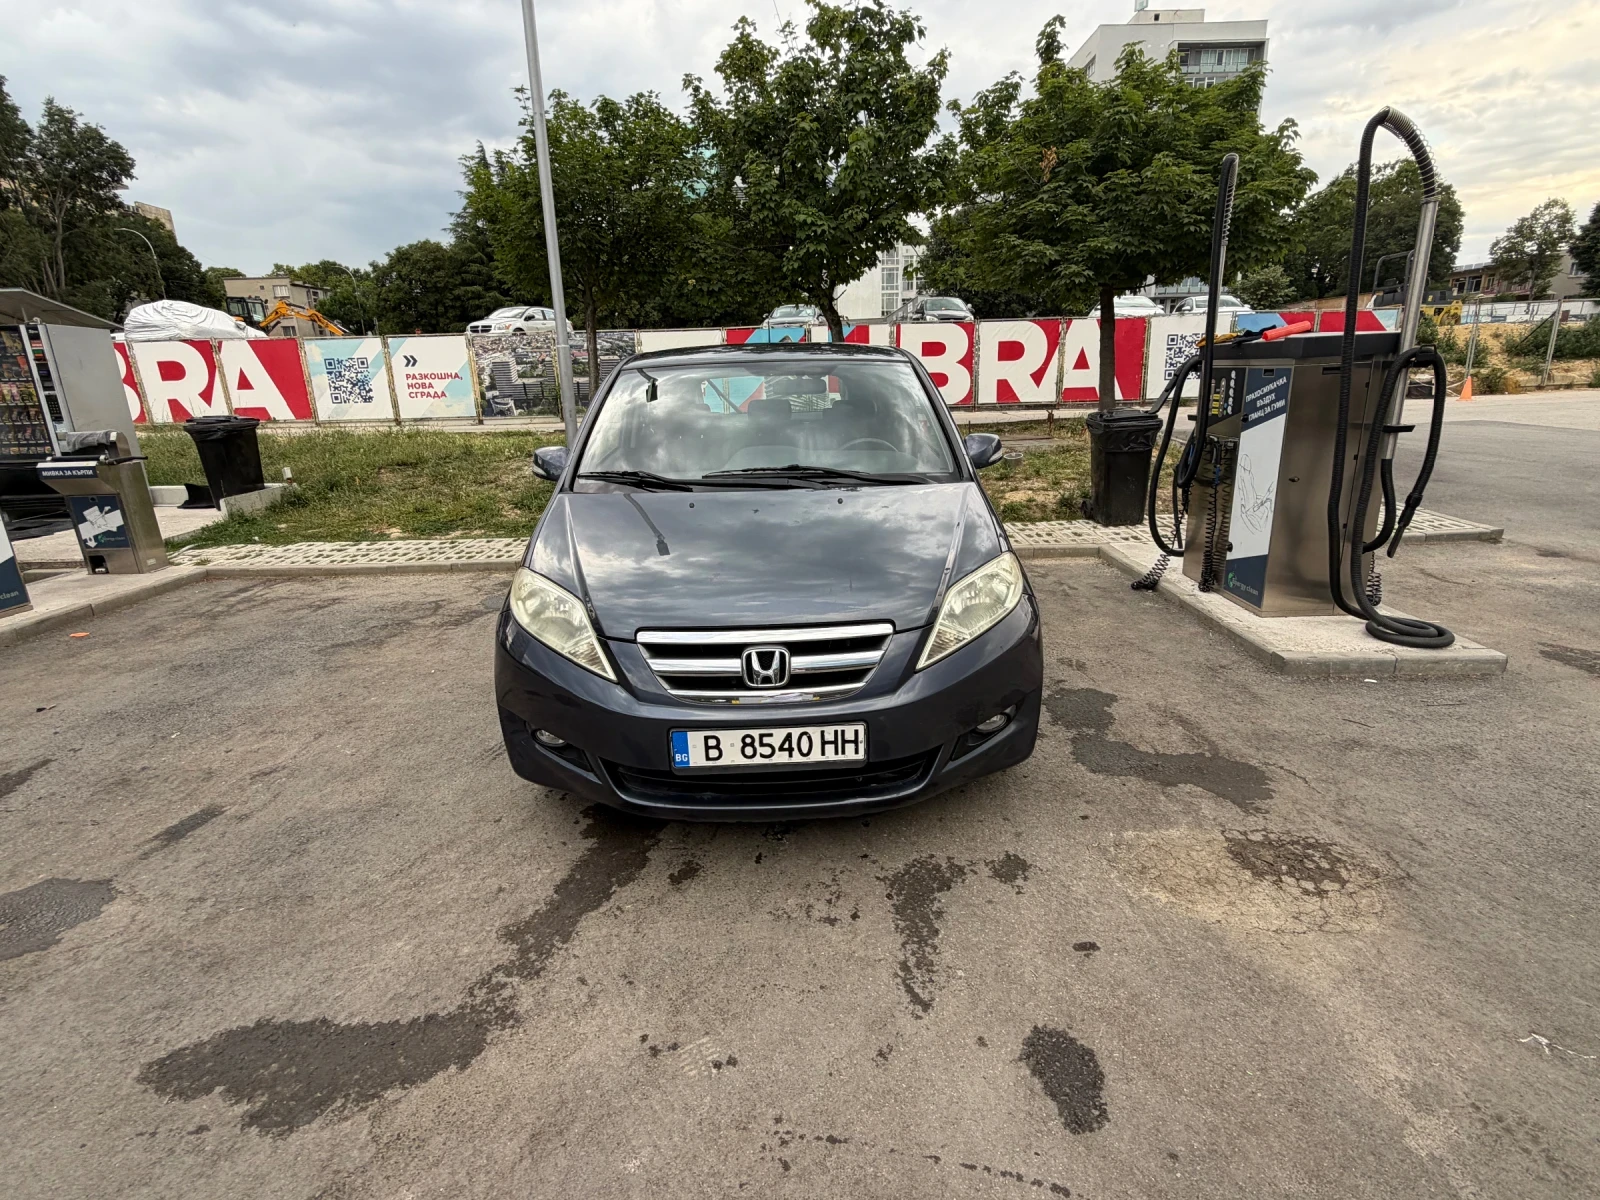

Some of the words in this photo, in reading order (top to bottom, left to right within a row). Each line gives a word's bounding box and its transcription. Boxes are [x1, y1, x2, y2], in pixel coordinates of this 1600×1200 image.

[405, 372, 463, 381] РАЗКОШНА,
[407, 382, 434, 390] НОВА
[1245, 376, 1288, 402] ПРАХОСМУКАЧКА
[408, 391, 447, 399] СГРАДА
[1256, 393, 1276, 408] ВЪЗДУХ
[1248, 407, 1265, 422] ГЛАНЦ
[1265, 405, 1272, 413] ЗА
[1271, 399, 1286, 411] ГУМИ
[740, 731, 814, 760] 8540
[675, 754, 688, 762] BG
